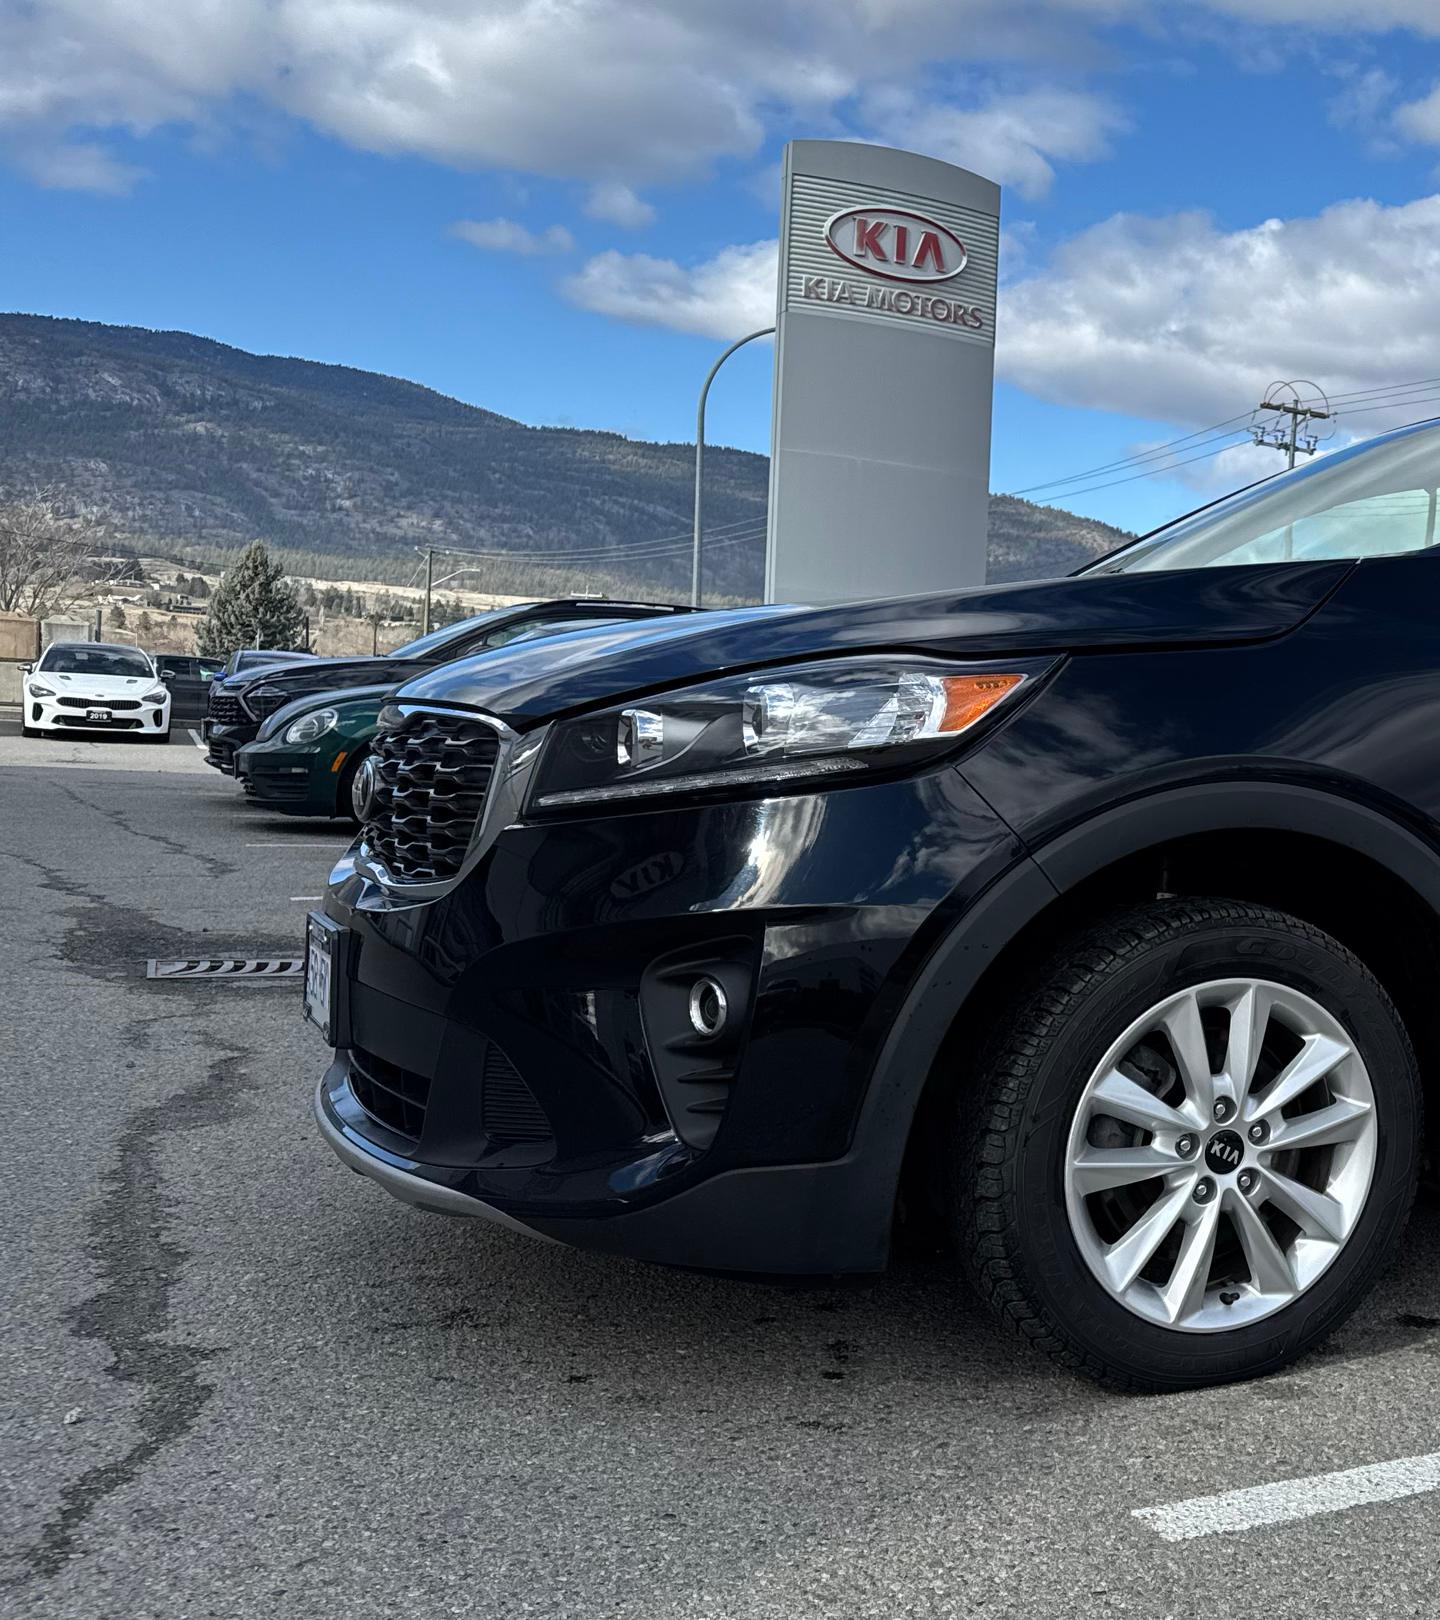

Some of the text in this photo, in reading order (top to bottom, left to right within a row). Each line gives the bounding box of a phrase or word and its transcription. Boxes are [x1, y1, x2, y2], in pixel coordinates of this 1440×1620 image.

[853, 217, 946, 273] KIA
[802, 275, 984, 329] KIA MOTORS
[1210, 1140, 1239, 1165] KIA
